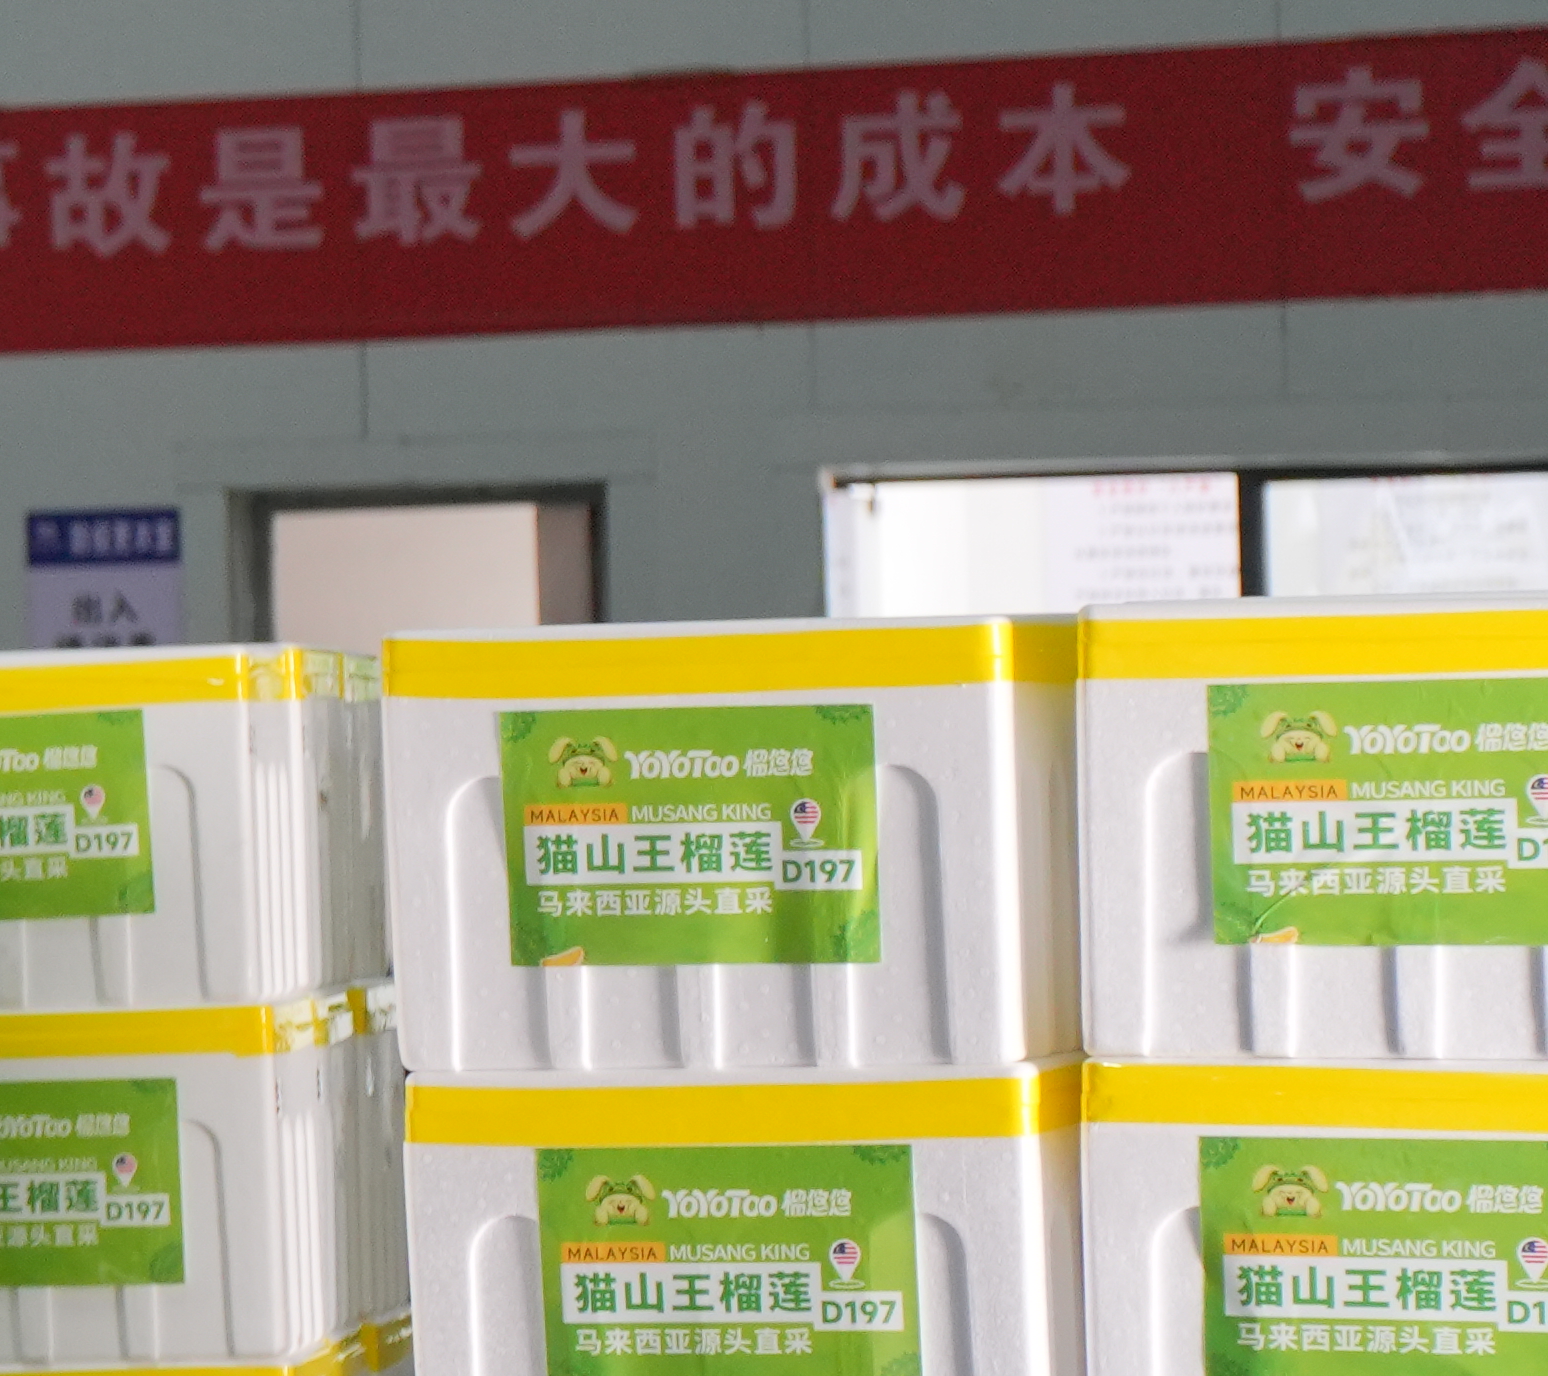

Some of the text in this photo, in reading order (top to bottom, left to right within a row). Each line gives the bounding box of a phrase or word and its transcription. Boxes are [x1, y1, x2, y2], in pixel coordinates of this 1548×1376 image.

[1239, 779, 1505, 802] MALAYSIA MUSANG KING
[529, 803, 771, 826] MALAYSIA MUSANG KING
[74, 832, 132, 854] D197
[1247, 808, 1506, 854] 猫山王榴莲
[536, 831, 773, 875] 猫山王榴莲
[781, 858, 855, 885] D197
[1246, 865, 1505, 897] 马来西亚源头直采
[539, 886, 771, 917] 马来西亚源头直采
[105, 1201, 164, 1223] D197
[567, 1243, 810, 1265] MALAYSIA MUSANG KING
[1228, 1237, 1496, 1261] MALAYSIA MUSANG KING
[575, 1271, 812, 1313] 猫山王榴莲
[1236, 1265, 1496, 1312] 猫山王榴莲
[821, 1300, 896, 1325] D197
[576, 1327, 812, 1355] 马来西亚源头直采
[1239, 1321, 1499, 1355] 马来西亚源头直采
